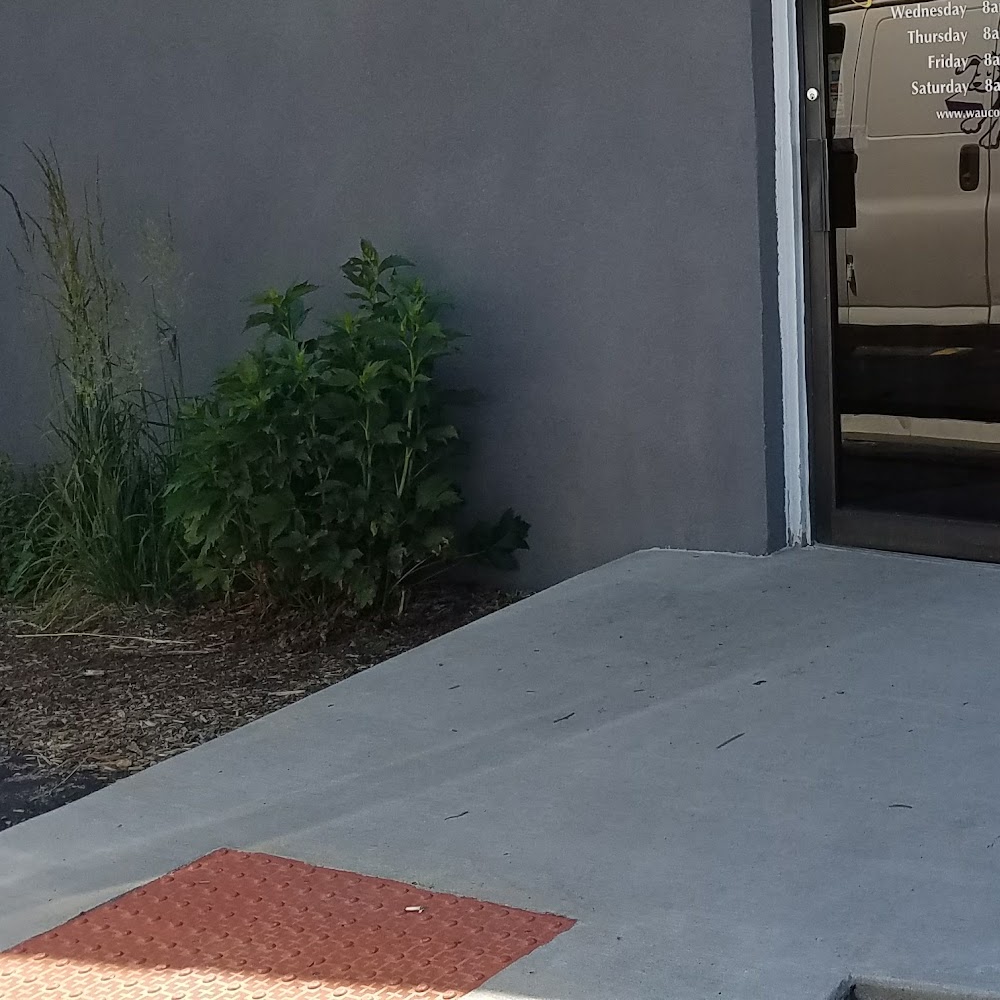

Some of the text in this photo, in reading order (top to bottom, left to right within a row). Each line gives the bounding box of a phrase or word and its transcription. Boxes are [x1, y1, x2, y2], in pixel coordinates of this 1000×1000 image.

[890, 3, 967, 20] Wednesday
[907, 28, 968, 45] Thursday
[928, 55, 969, 70] Friday
[911, 80, 970, 96] Saturday
